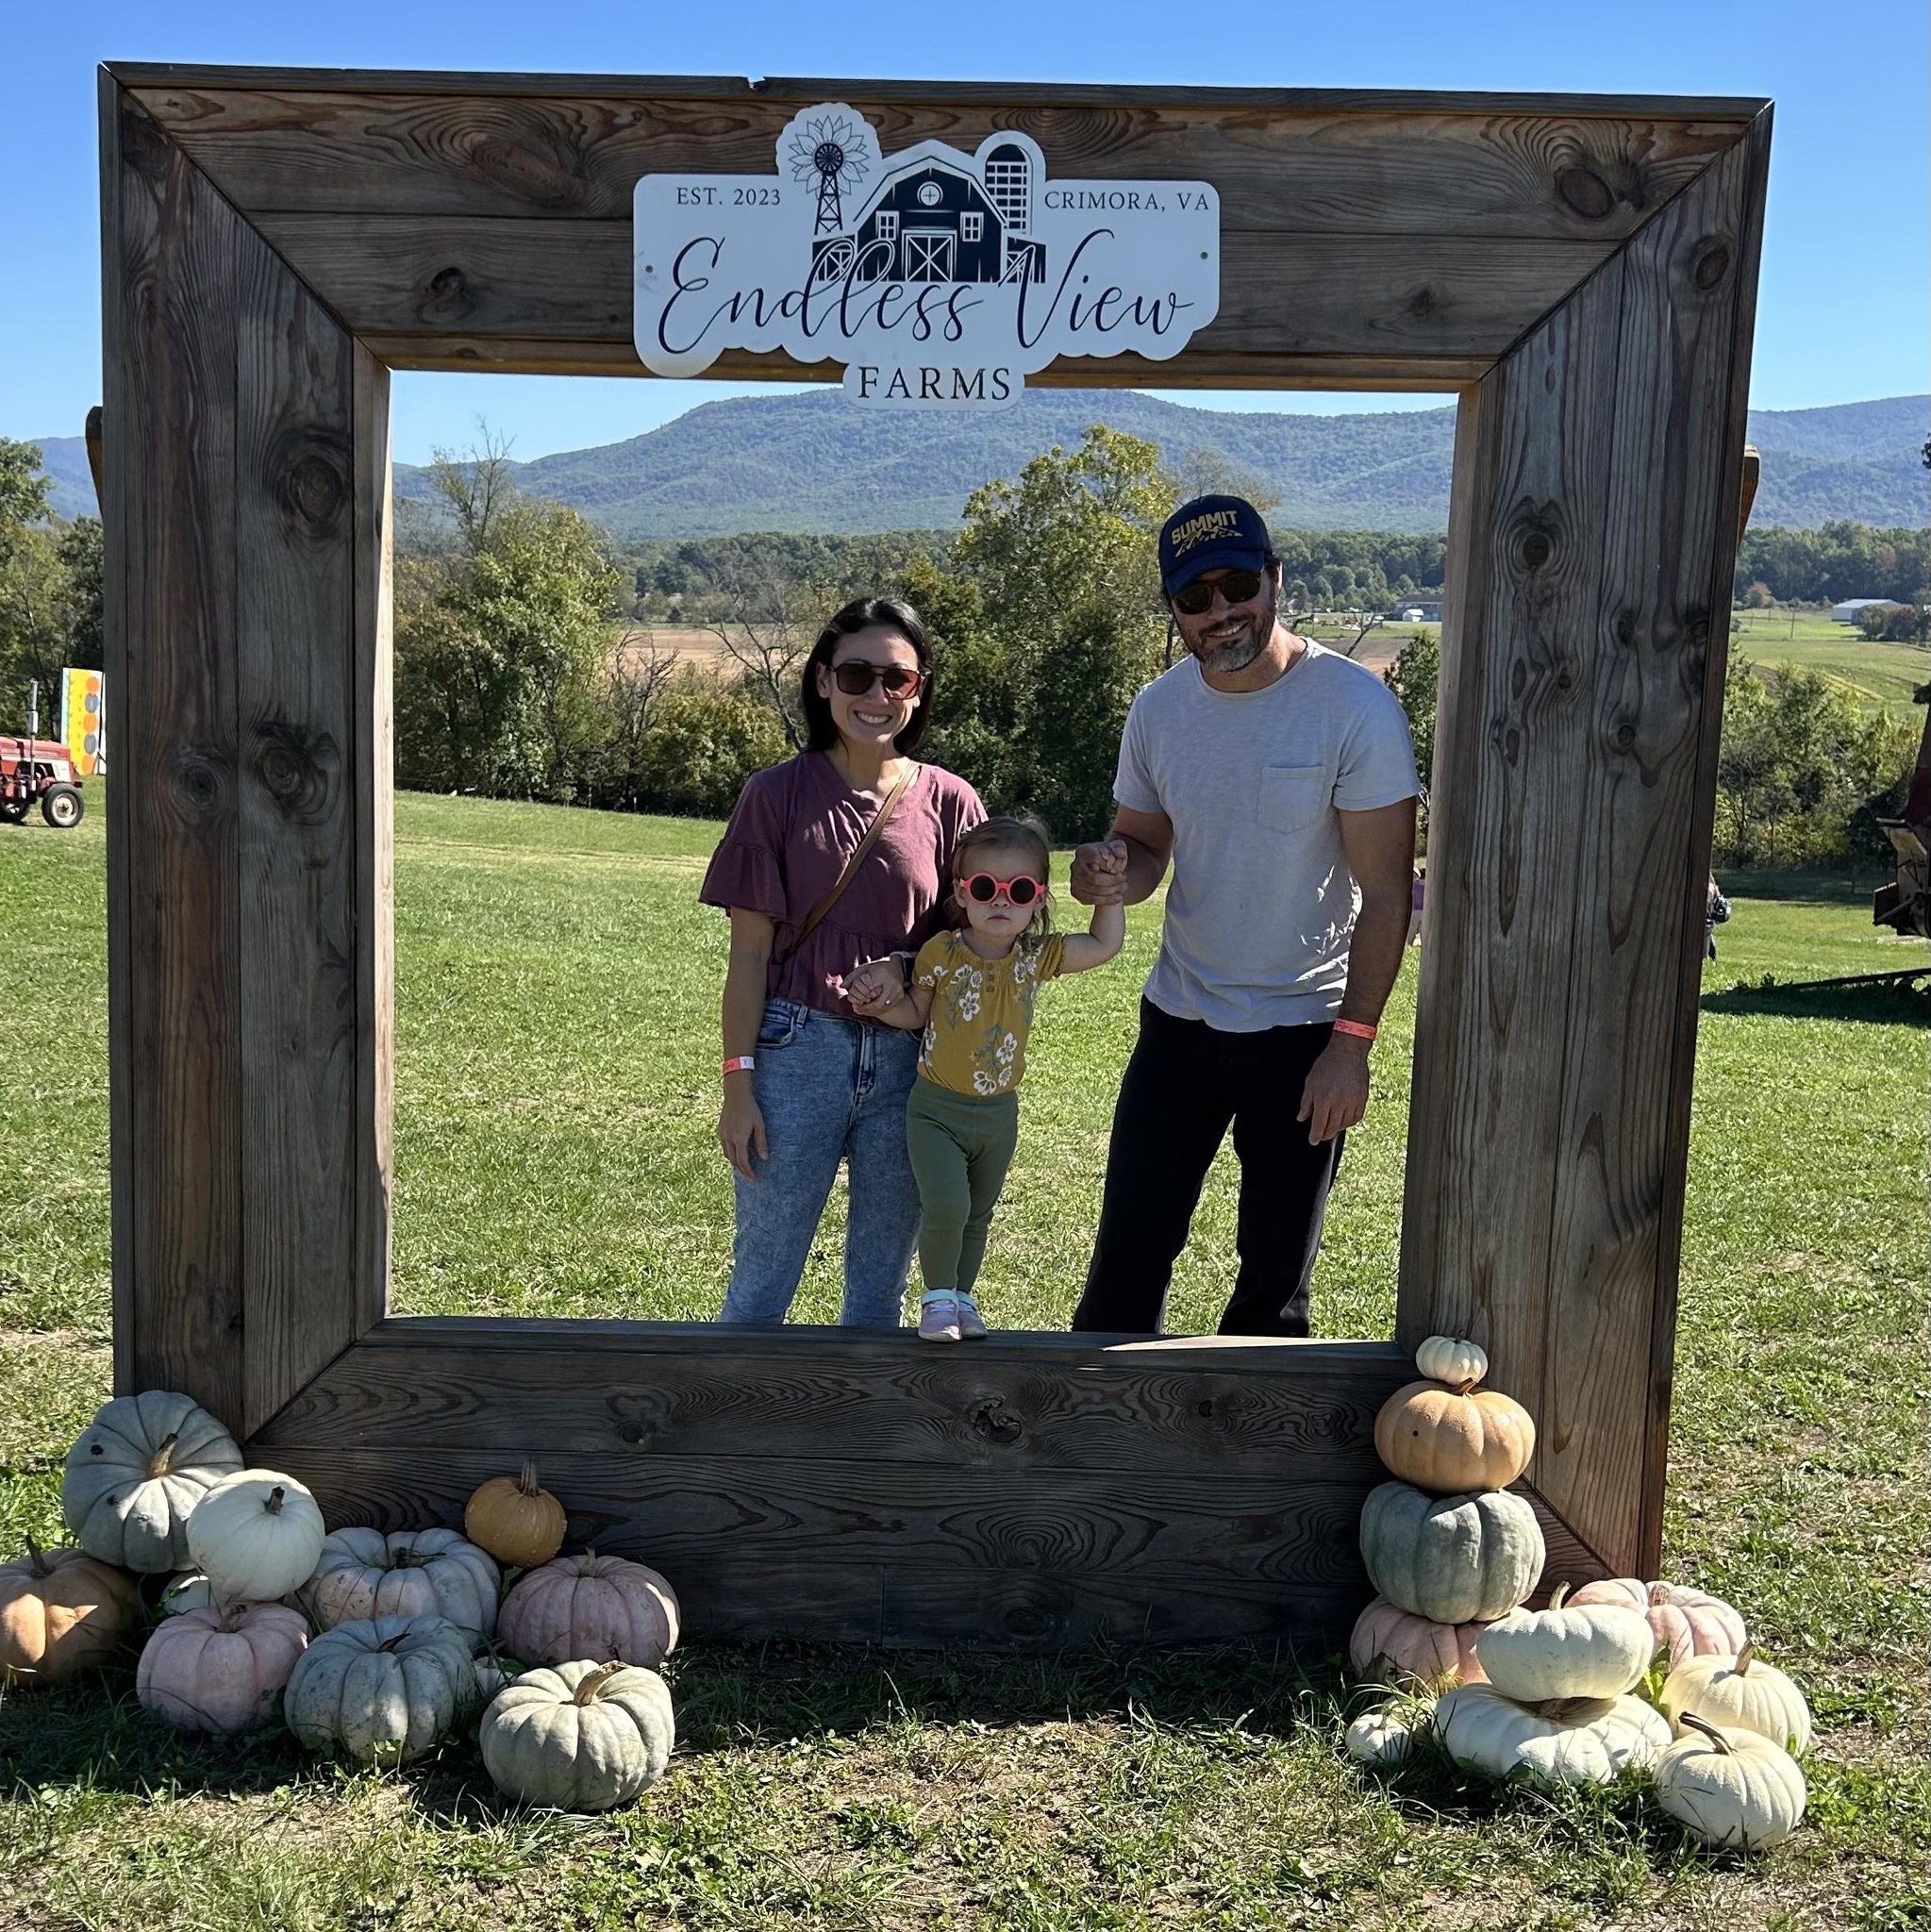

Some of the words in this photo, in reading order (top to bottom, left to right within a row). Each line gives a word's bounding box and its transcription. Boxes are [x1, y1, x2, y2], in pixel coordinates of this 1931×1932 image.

[676, 187, 724, 206] EST.
[734, 188, 781, 206] 2023
[1044, 192, 1166, 212] CRIMORA,
[1177, 192, 1209, 210] VA
[659, 237, 984, 354] Endless
[997, 229, 1194, 349] View
[857, 367, 1011, 400] FARMS
[1171, 510, 1238, 545] SUMMIT
